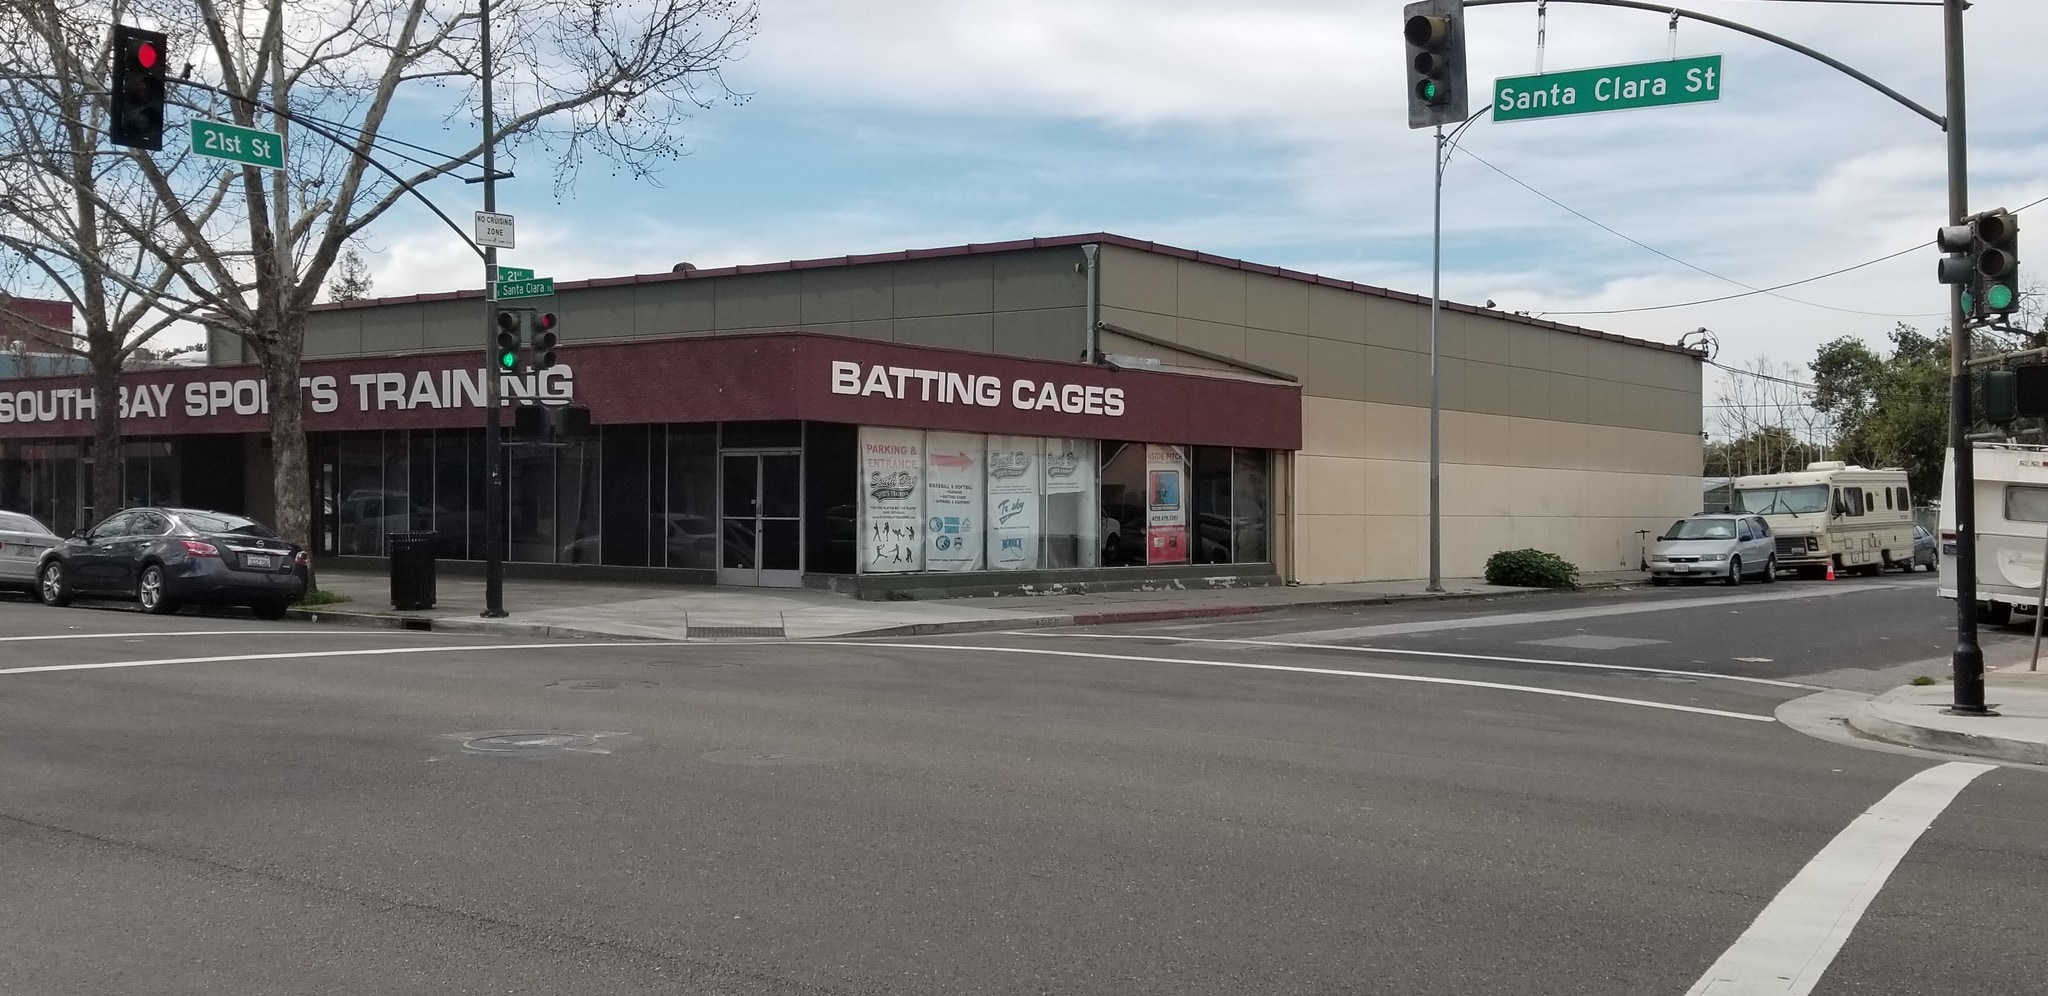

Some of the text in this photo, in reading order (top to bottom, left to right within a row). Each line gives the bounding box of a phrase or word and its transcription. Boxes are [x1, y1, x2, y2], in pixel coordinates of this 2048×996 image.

[1500, 66, 1716, 111] Santa Clara St
[203, 130, 271, 159] 21st St
[477, 215, 513, 226] NO CRUISING
[487, 227, 504, 236] ZONE
[503, 284, 524, 296] Santa
[526, 282, 545, 294] Clara
[0, 388, 95, 423] SOUTH
[185, 375, 338, 417] SPOS
[350, 363, 573, 411] TRAINNG
[832, 360, 1125, 417] BATTING CAGES
[867, 444, 917, 456] PARKING &
[1149, 452, 1165, 460] SIDE
[868, 458, 917, 469] ENTRANCE
[870, 471, 897, 488] South
